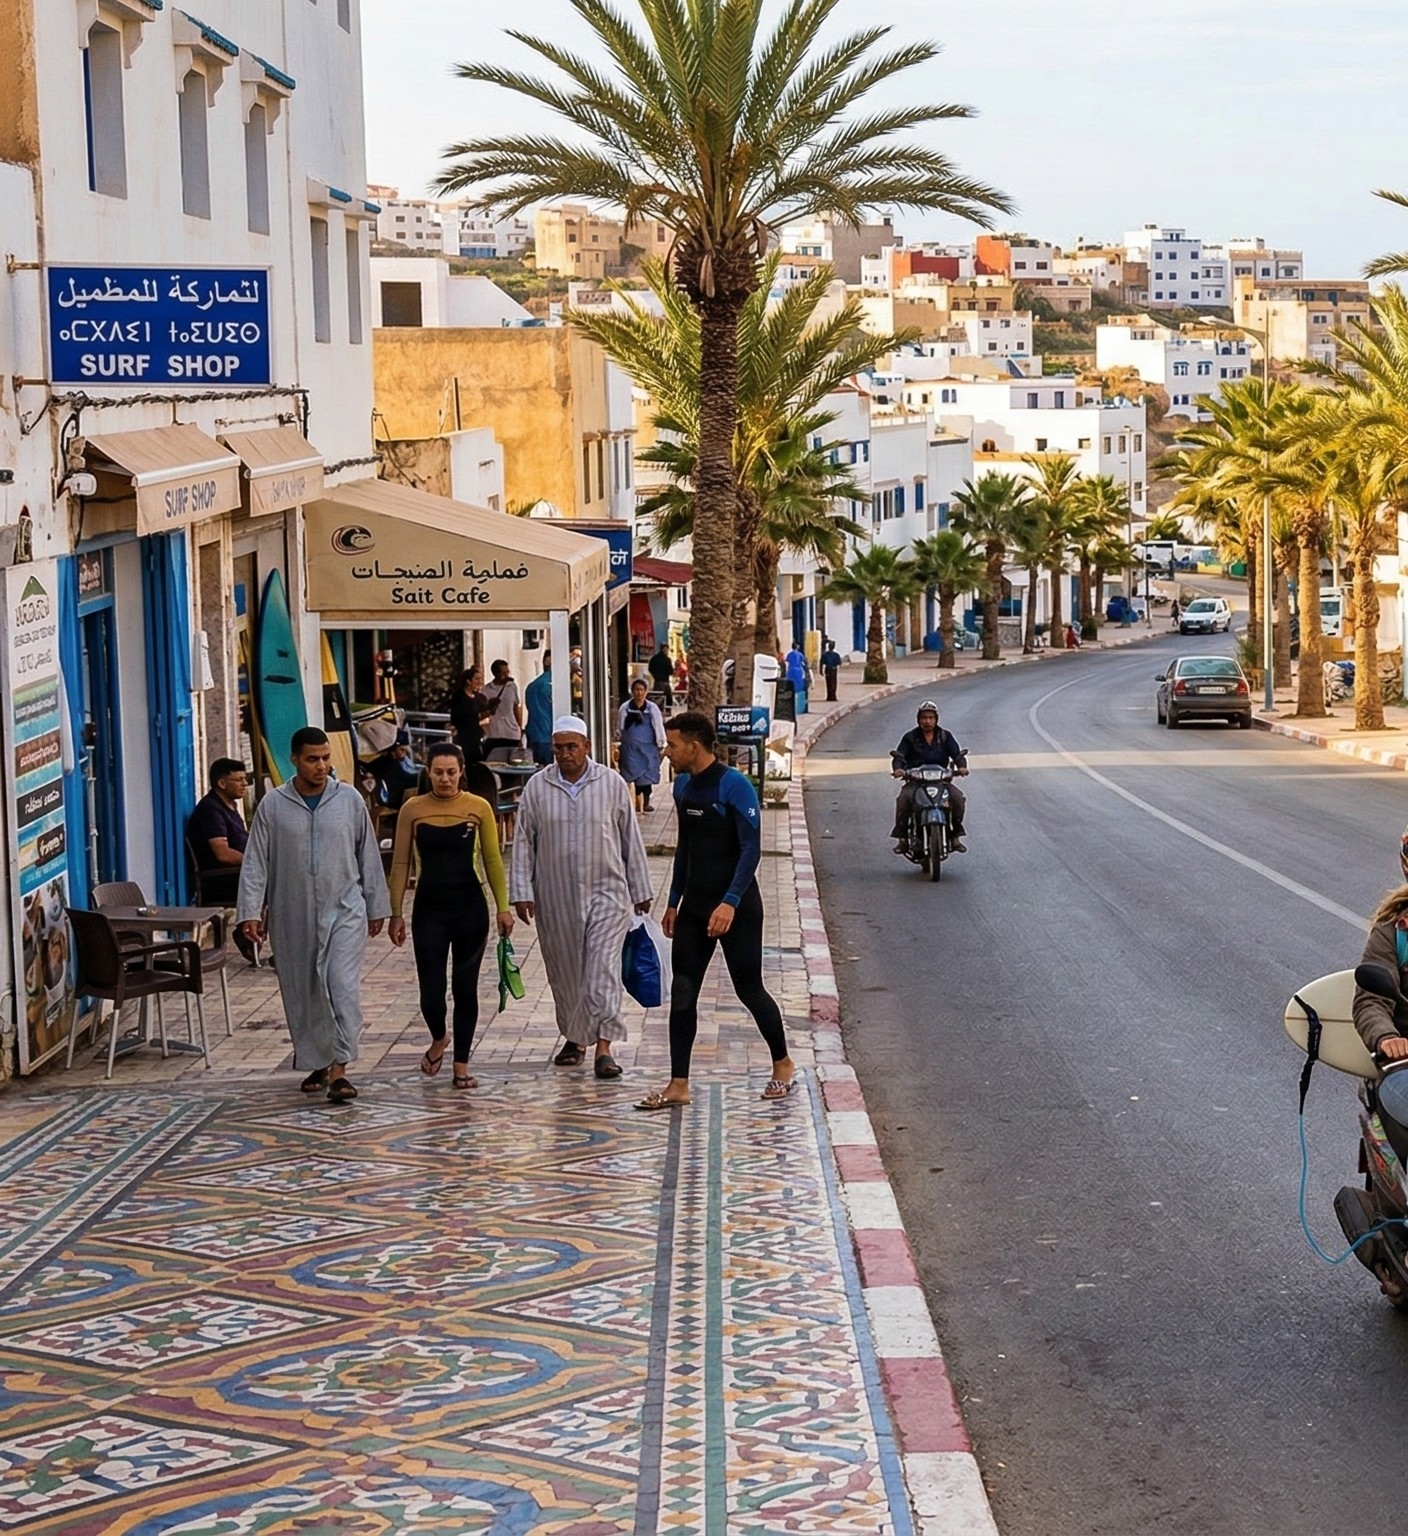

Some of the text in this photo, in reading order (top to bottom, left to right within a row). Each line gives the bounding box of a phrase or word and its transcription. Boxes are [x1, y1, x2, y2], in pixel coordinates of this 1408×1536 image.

[80, 354, 240, 377] SURF SHOP
[192, 480, 216, 512] SHOP
[391, 587, 491, 604] Sait Cafe
